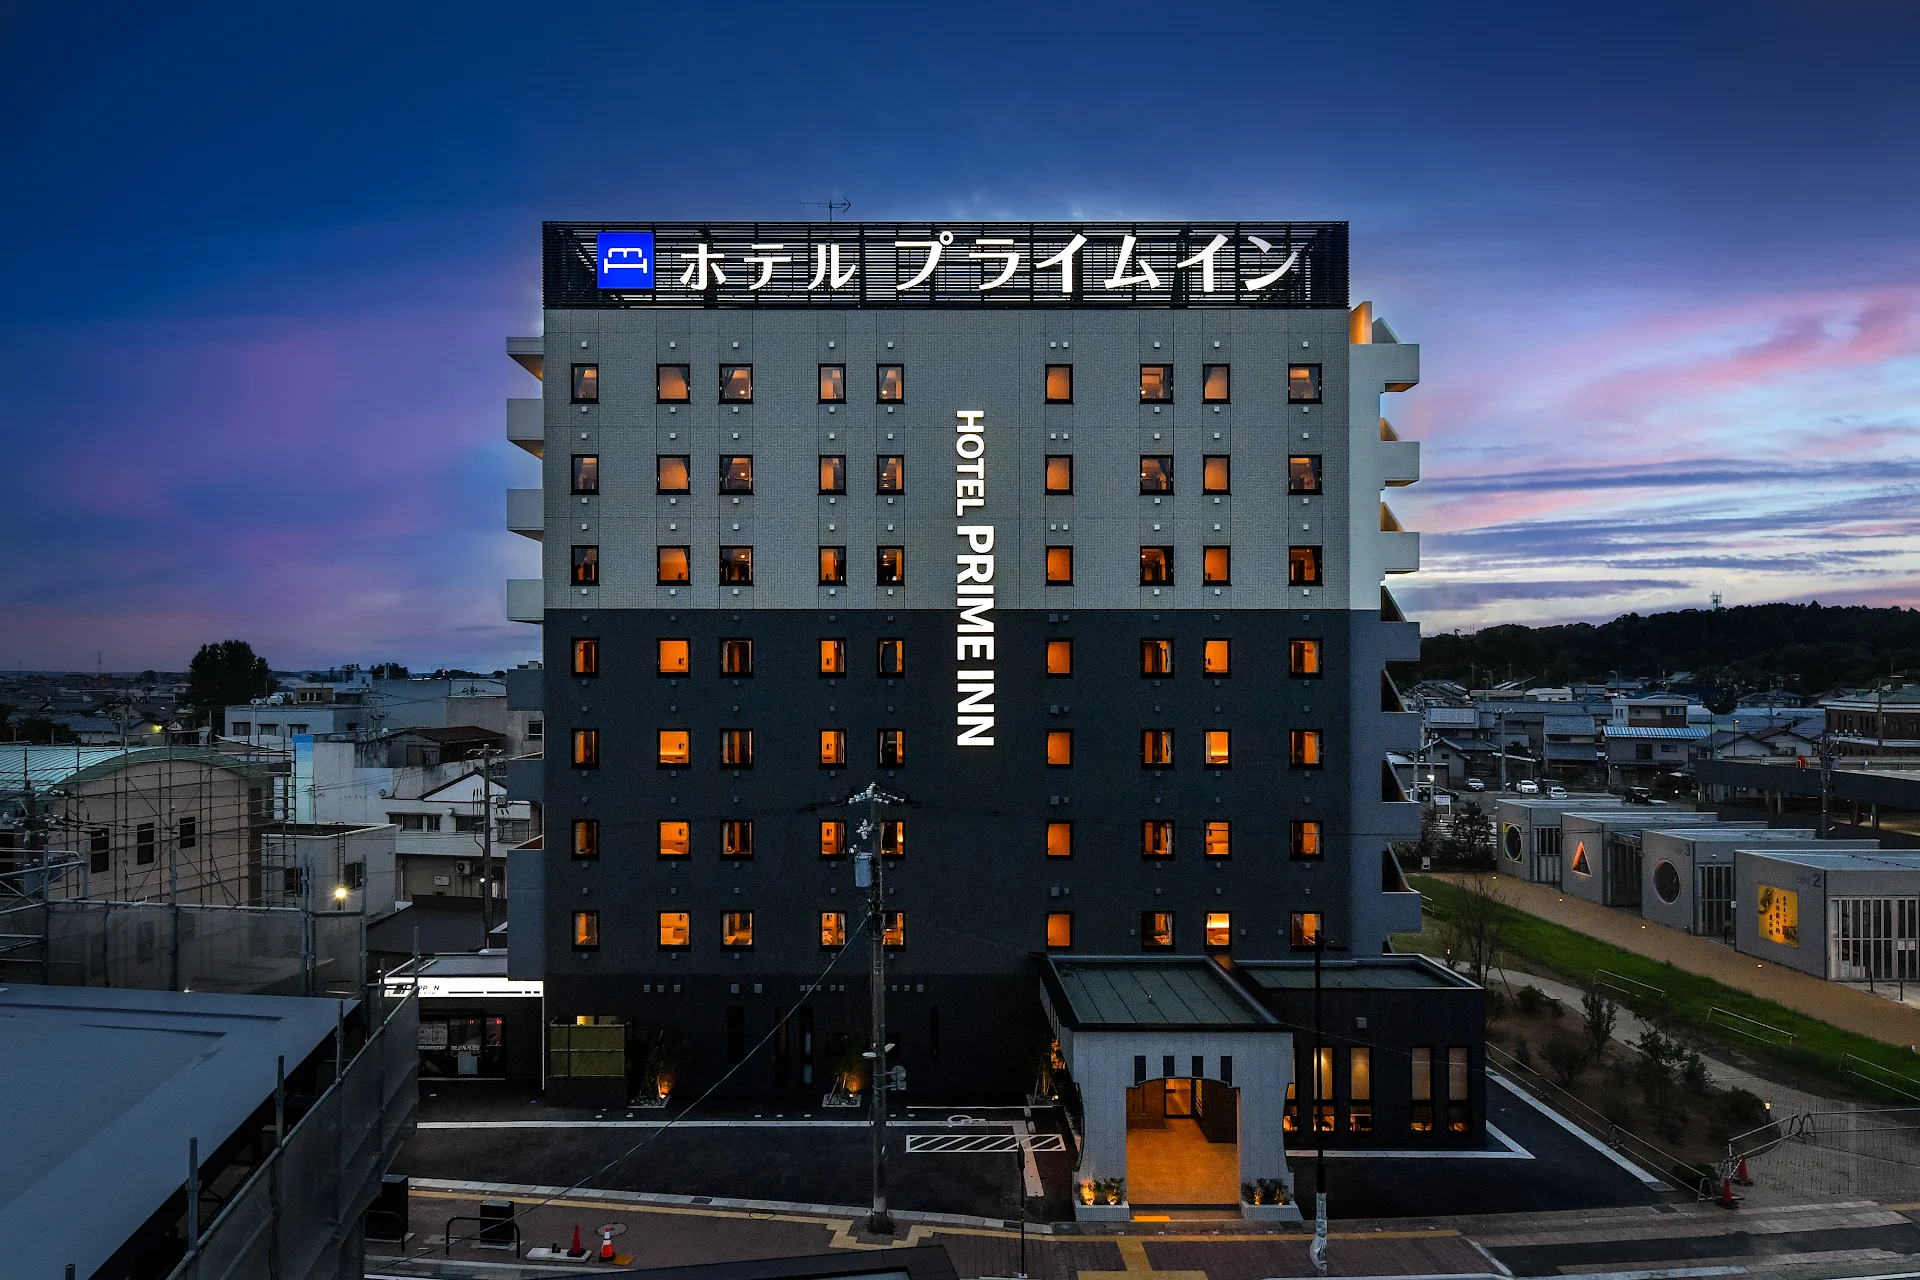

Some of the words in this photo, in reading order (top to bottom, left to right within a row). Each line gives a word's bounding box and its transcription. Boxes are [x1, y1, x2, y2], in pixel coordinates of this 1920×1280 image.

[679, 243, 857, 291] ホテル
[894, 230, 1299, 293] プライムイン
[956, 410, 985, 517] HOTEL
[956, 525, 995, 661] PRIME
[956, 670, 995, 746] INN
[1684, 844, 1691, 857] 3
[1813, 873, 1822, 888] 2
